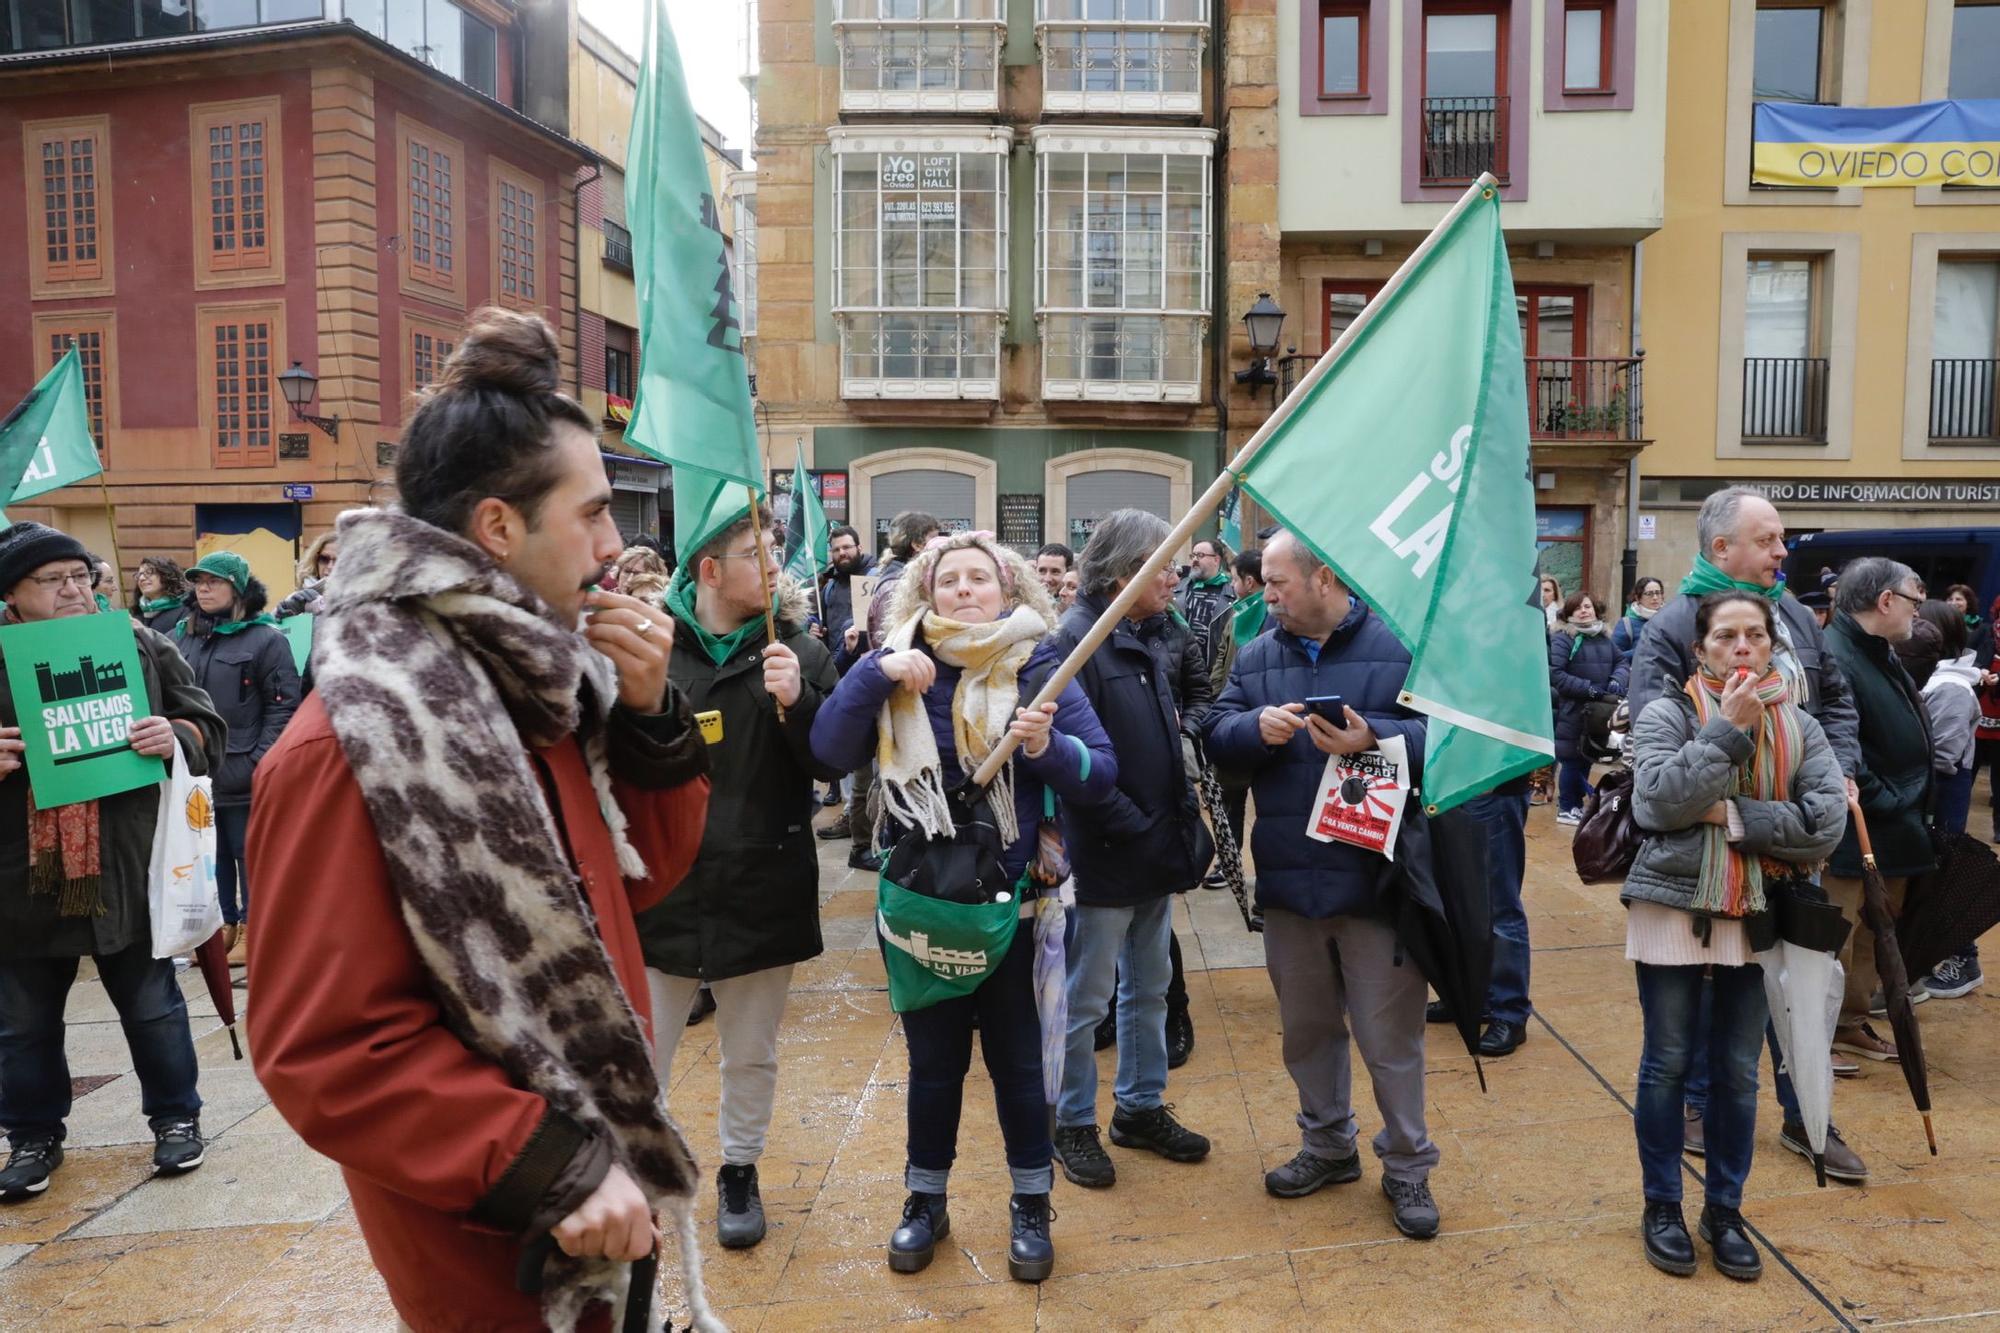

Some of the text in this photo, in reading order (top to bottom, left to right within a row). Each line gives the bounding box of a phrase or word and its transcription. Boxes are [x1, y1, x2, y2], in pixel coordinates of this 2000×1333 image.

[923, 157, 953, 166] LOFT
[1799, 150, 1928, 178] OVIEDO
[883, 172, 915, 182] creo
[925, 168, 951, 177] CITY
[922, 179, 953, 188] HALL
[1798, 485, 1819, 499] DE
[1823, 483, 1941, 499] INFORMACIÓN
[1944, 482, 2000, 500] TURÍST
[1368, 471, 1455, 579] LA
[42, 694, 133, 729] SALVEMOS
[48, 727, 82, 755] LA
[934, 961, 950, 974] LA
